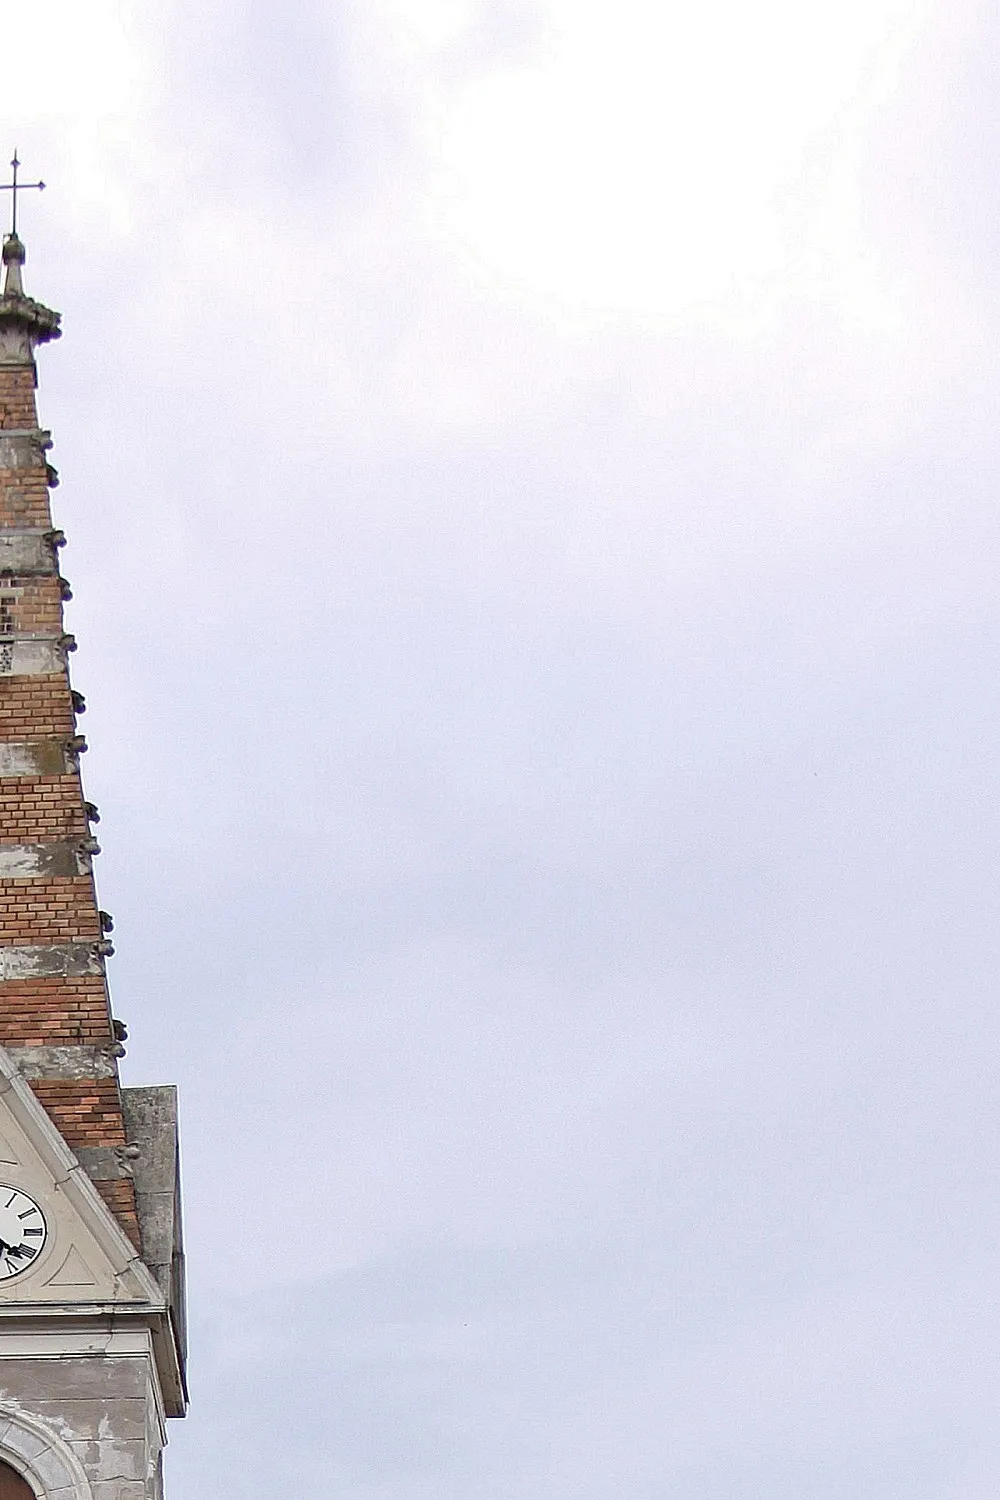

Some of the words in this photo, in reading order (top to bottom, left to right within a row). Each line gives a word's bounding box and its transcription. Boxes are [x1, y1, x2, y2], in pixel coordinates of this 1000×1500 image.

[5, 1193, 18, 1208] I
[17, 1207, 37, 1220] II
[23, 1228, 43, 1236] III
[4, 1257, 19, 1274] V
